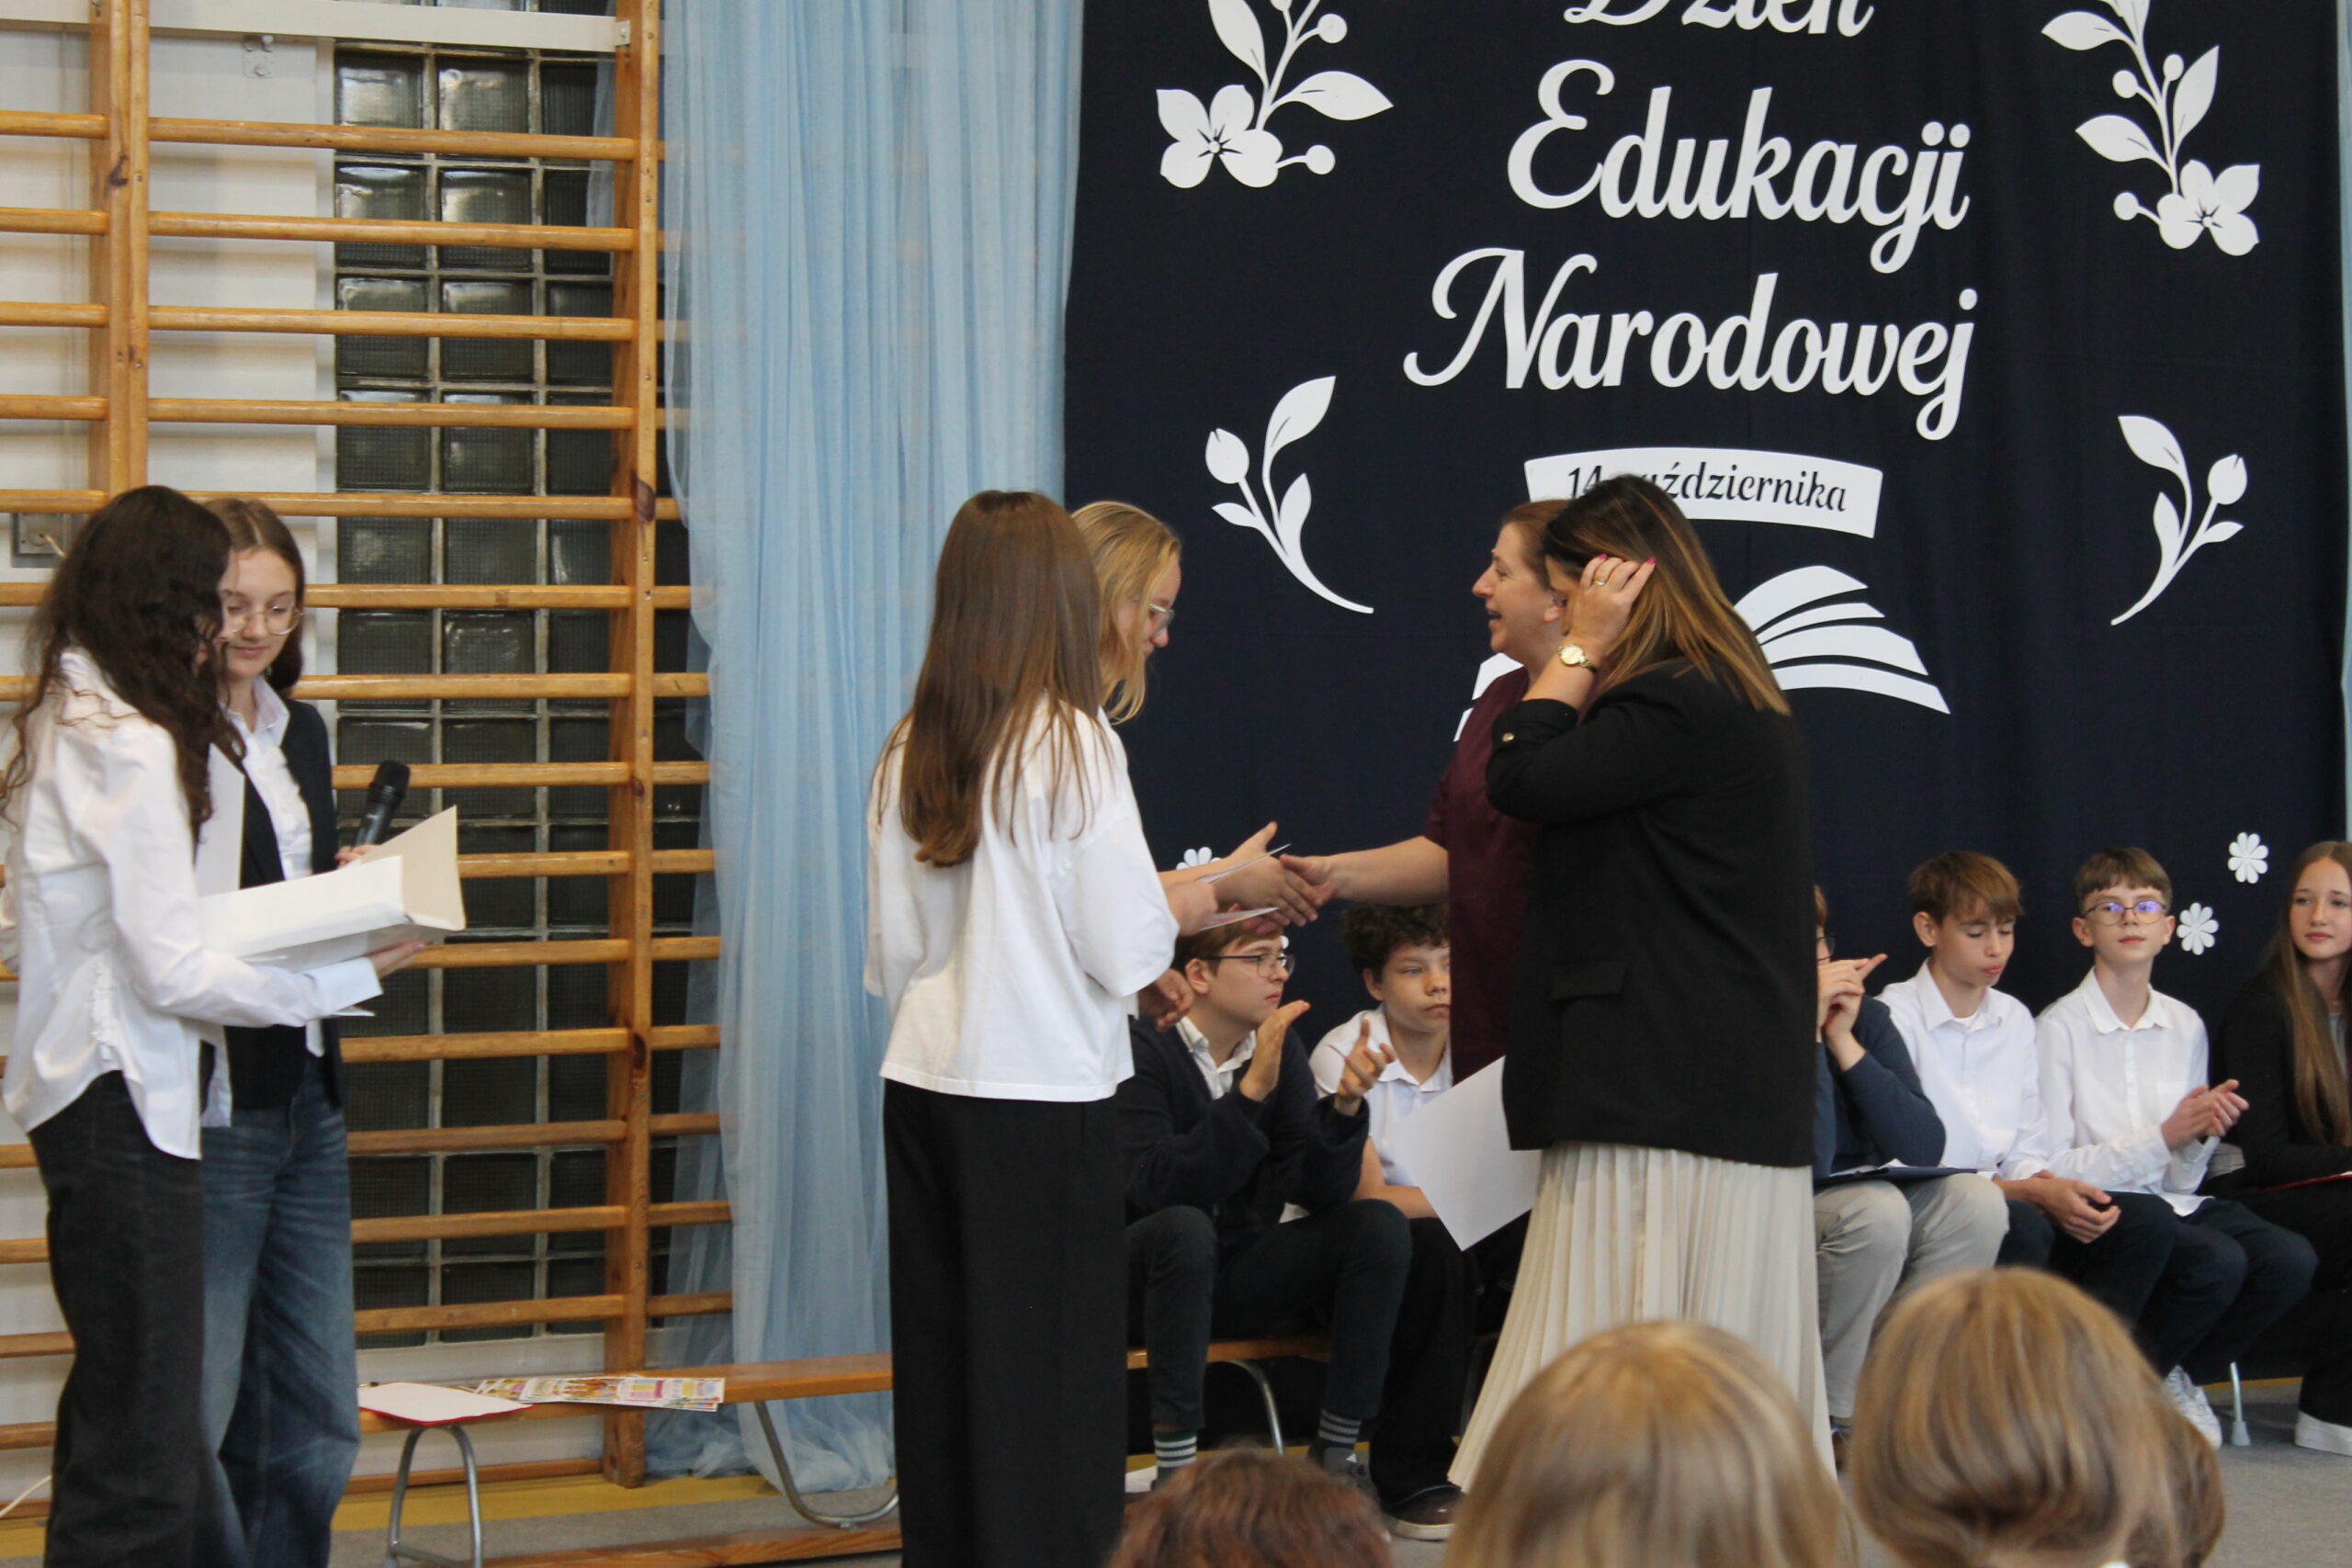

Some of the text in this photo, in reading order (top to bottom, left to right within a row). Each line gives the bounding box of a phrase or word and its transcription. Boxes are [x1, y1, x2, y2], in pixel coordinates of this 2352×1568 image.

[1508, 59, 1971, 274] Edukacji
[1403, 247, 1978, 440] Narodowej
[1640, 461, 1847, 512] ździernika
